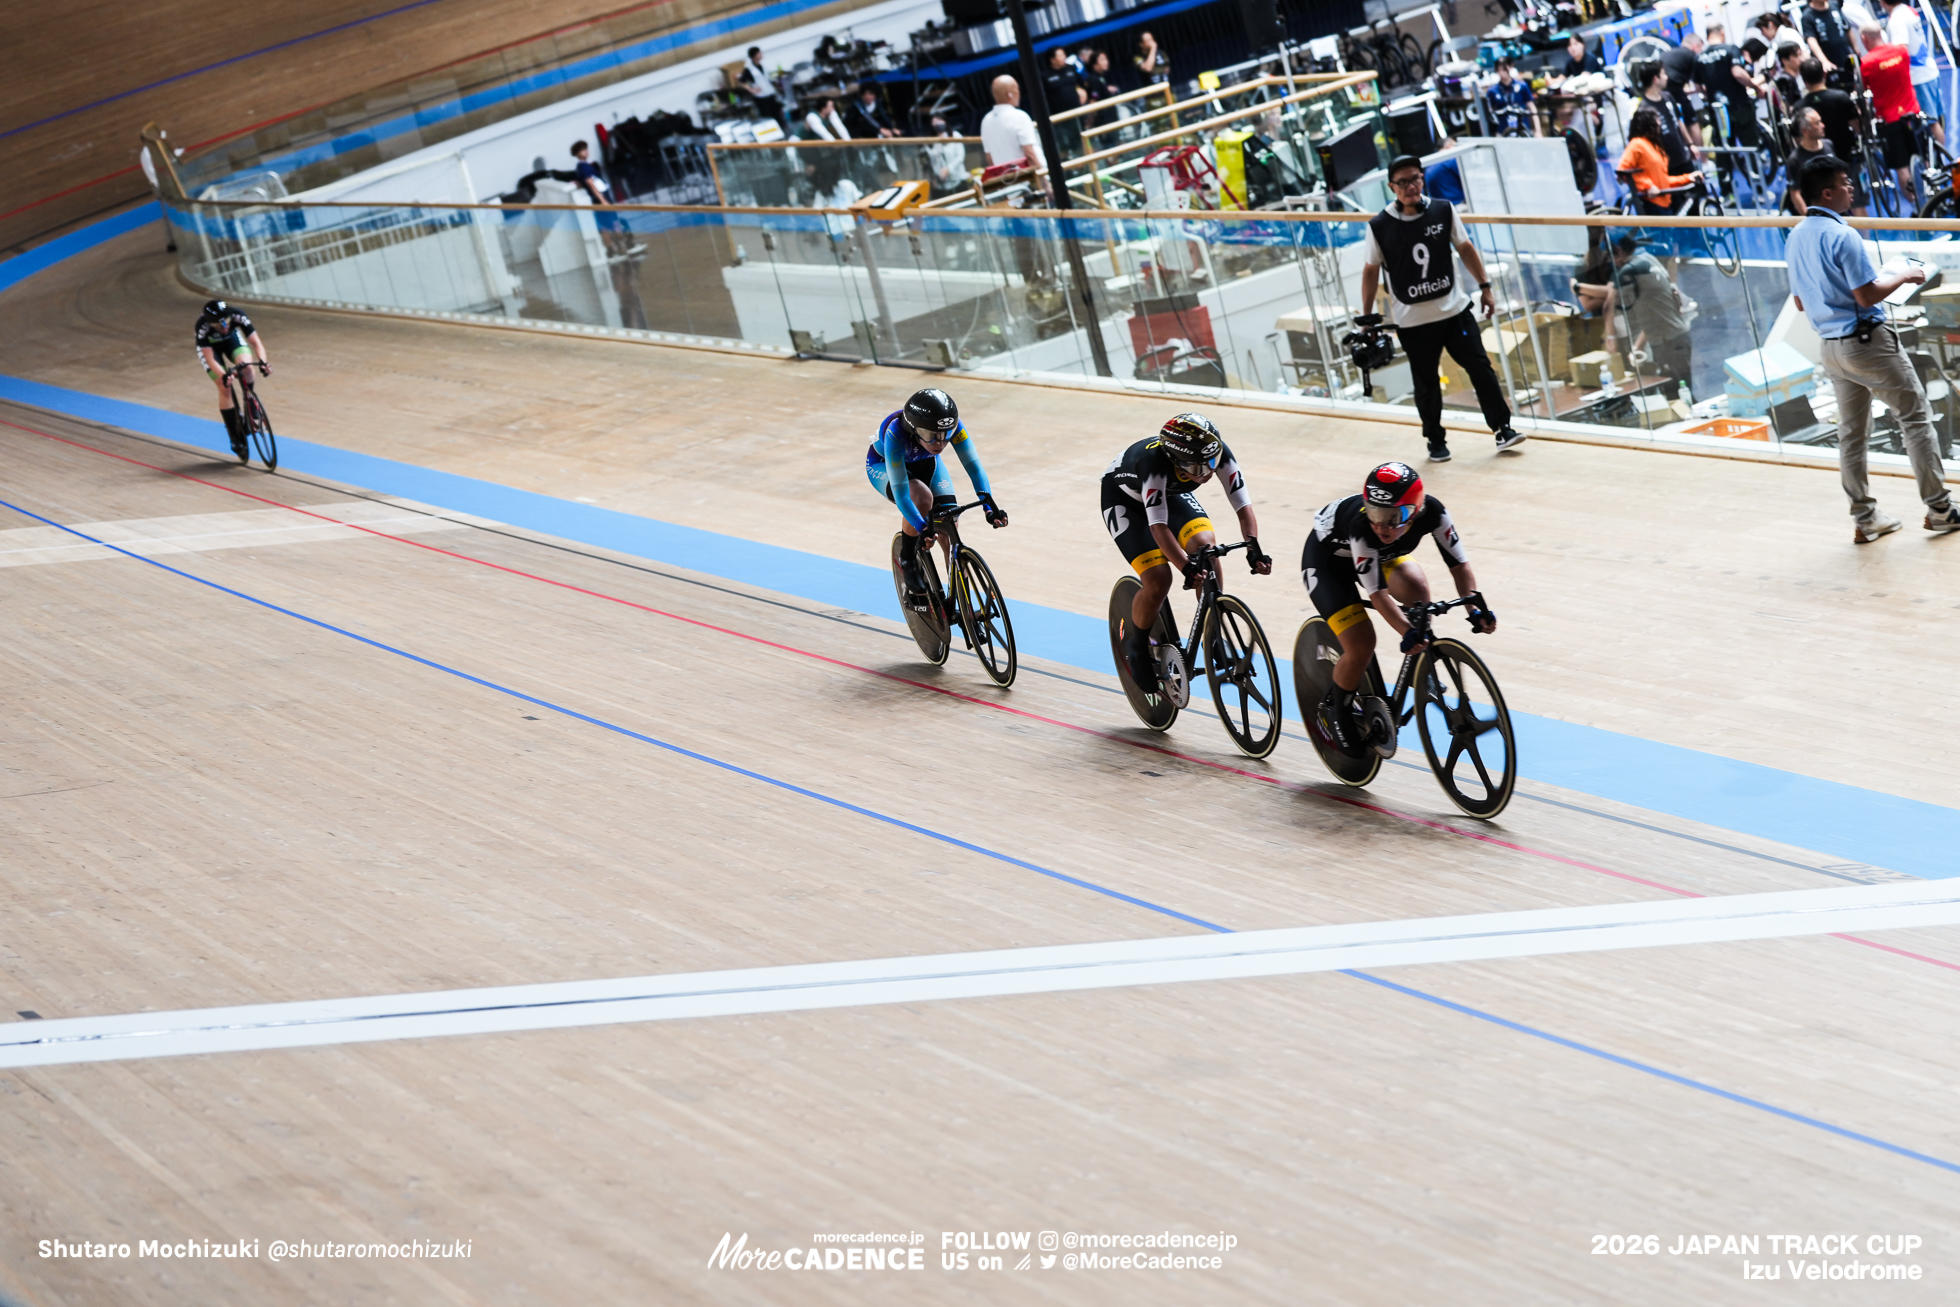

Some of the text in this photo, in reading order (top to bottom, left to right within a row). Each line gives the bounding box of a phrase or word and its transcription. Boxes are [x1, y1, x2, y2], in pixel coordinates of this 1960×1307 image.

[1424, 224, 1443, 236] JCF
[1412, 243, 1430, 279] 9
[1408, 276, 1450, 297] Official
[1165, 441, 1194, 455] Kabuto
